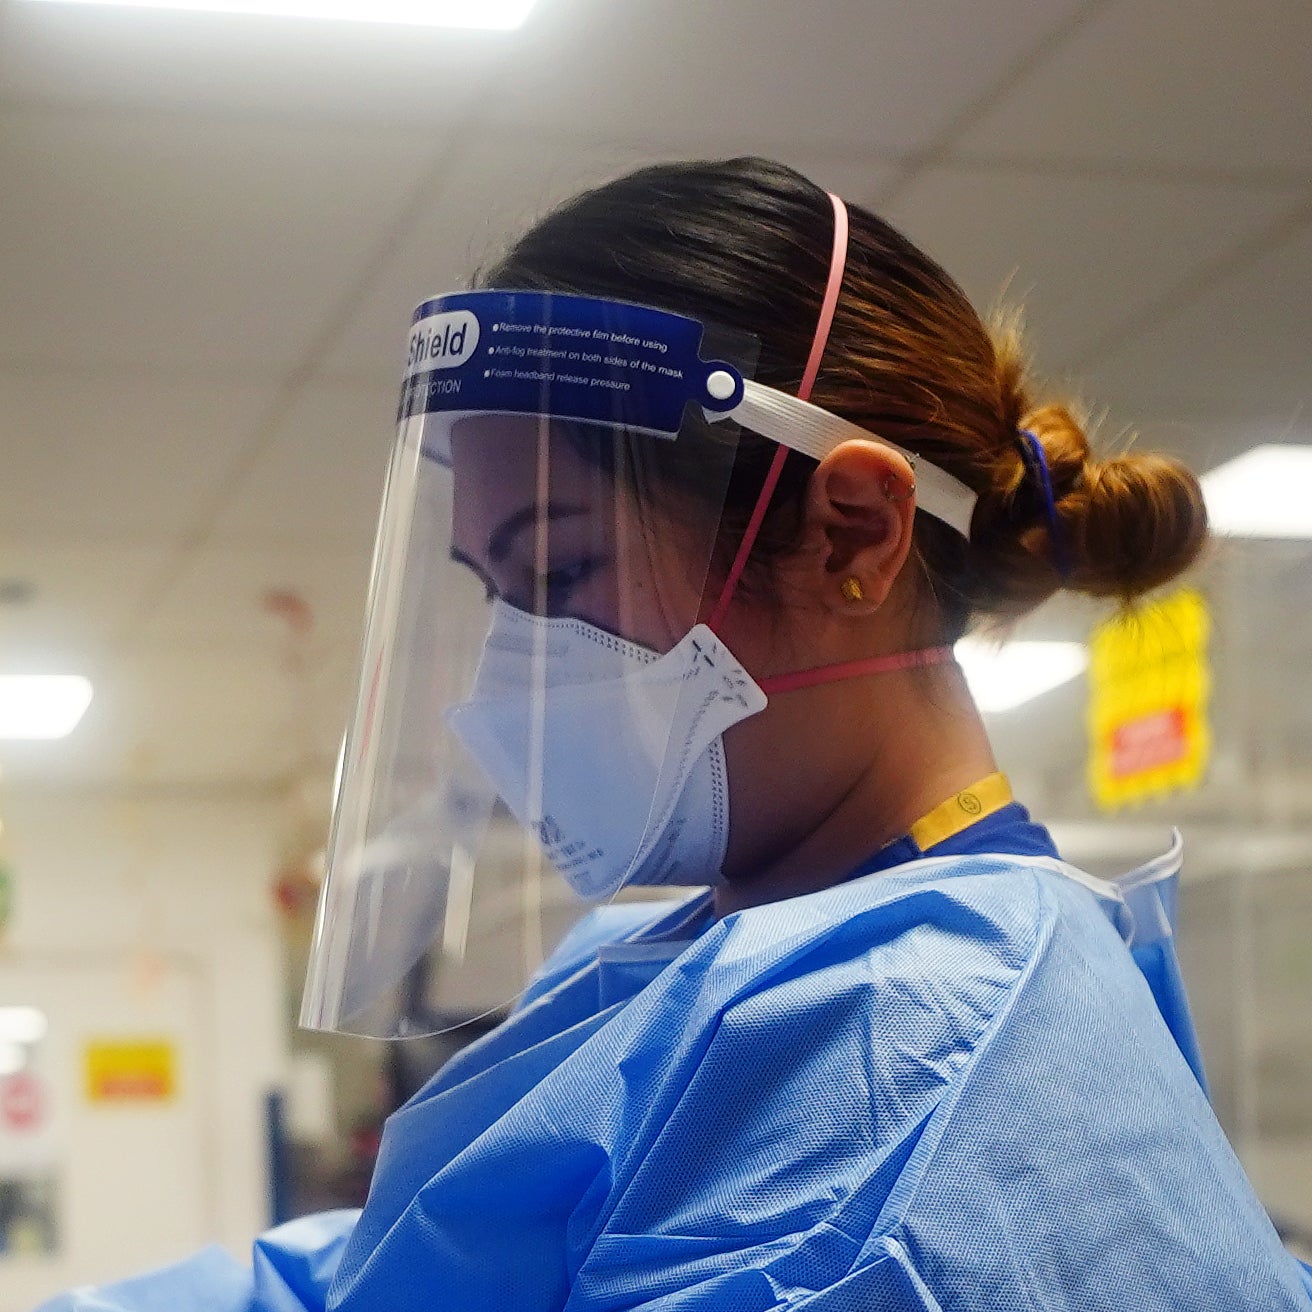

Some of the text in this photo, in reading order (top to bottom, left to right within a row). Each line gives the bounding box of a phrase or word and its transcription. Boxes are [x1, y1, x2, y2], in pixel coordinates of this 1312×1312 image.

[499, 322, 669, 353] Remove the protective film before using
[527, 347, 567, 359] treatment
[568, 351, 581, 361] on
[582, 352, 602, 363] both
[603, 355, 628, 368] sides
[629, 358, 641, 369] of
[641, 361, 657, 373] the
[658, 365, 684, 380] mask
[514, 370, 555, 382] headband
[556, 373, 589, 386] release
[590, 377, 631, 392] pressure
